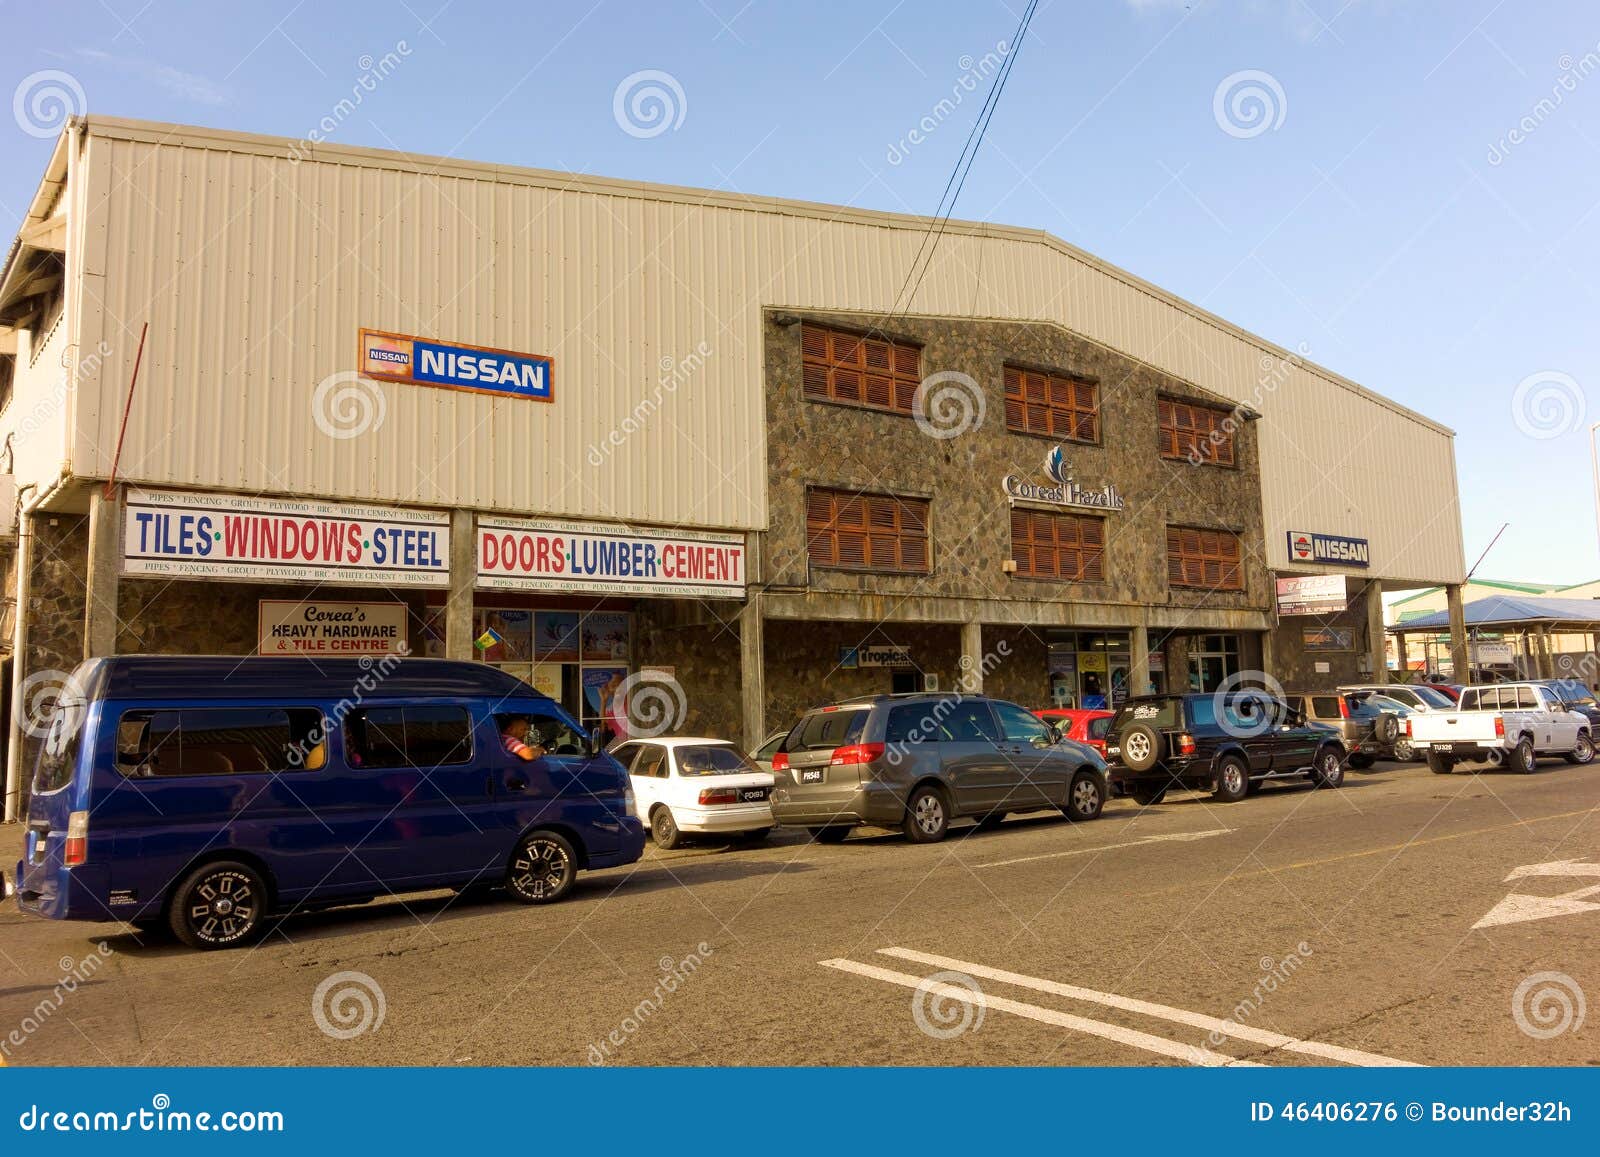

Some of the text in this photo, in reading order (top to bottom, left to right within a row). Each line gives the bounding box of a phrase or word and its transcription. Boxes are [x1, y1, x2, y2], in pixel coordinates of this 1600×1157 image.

[370, 350, 408, 363] NISSAN
[421, 349, 544, 389] NISSAN
[1002, 475, 1064, 500] Coreas
[149, 493, 174, 503] PIPES
[183, 495, 222, 506] FENCING
[230, 498, 261, 509] GROUT
[269, 502, 309, 513] PLYWOOD
[317, 505, 333, 513] BRC
[341, 507, 364, 517] WHITE
[367, 509, 398, 519] CEMENT
[560, 523, 585, 532] GROUT
[592, 525, 626, 534] PLYWOOD
[136, 512, 442, 567] TILES WINDOWS STEEL
[482, 532, 740, 581] DOORS LUMBER CEMENT
[1314, 538, 1368, 562] NISSAN
[144, 562, 435, 582] PIPES FENCING GROUT PLYWOOD BRC WHITE CEMENT THINSET
[493, 579, 514, 587] PIPES
[560, 582, 585, 590] GROUT
[592, 583, 626, 592] PLYWOOD
[304, 606, 366, 622] Corea's
[272, 624, 397, 638] HEAVY HARDWARE
[277, 639, 389, 650] & TILE CENTRE
